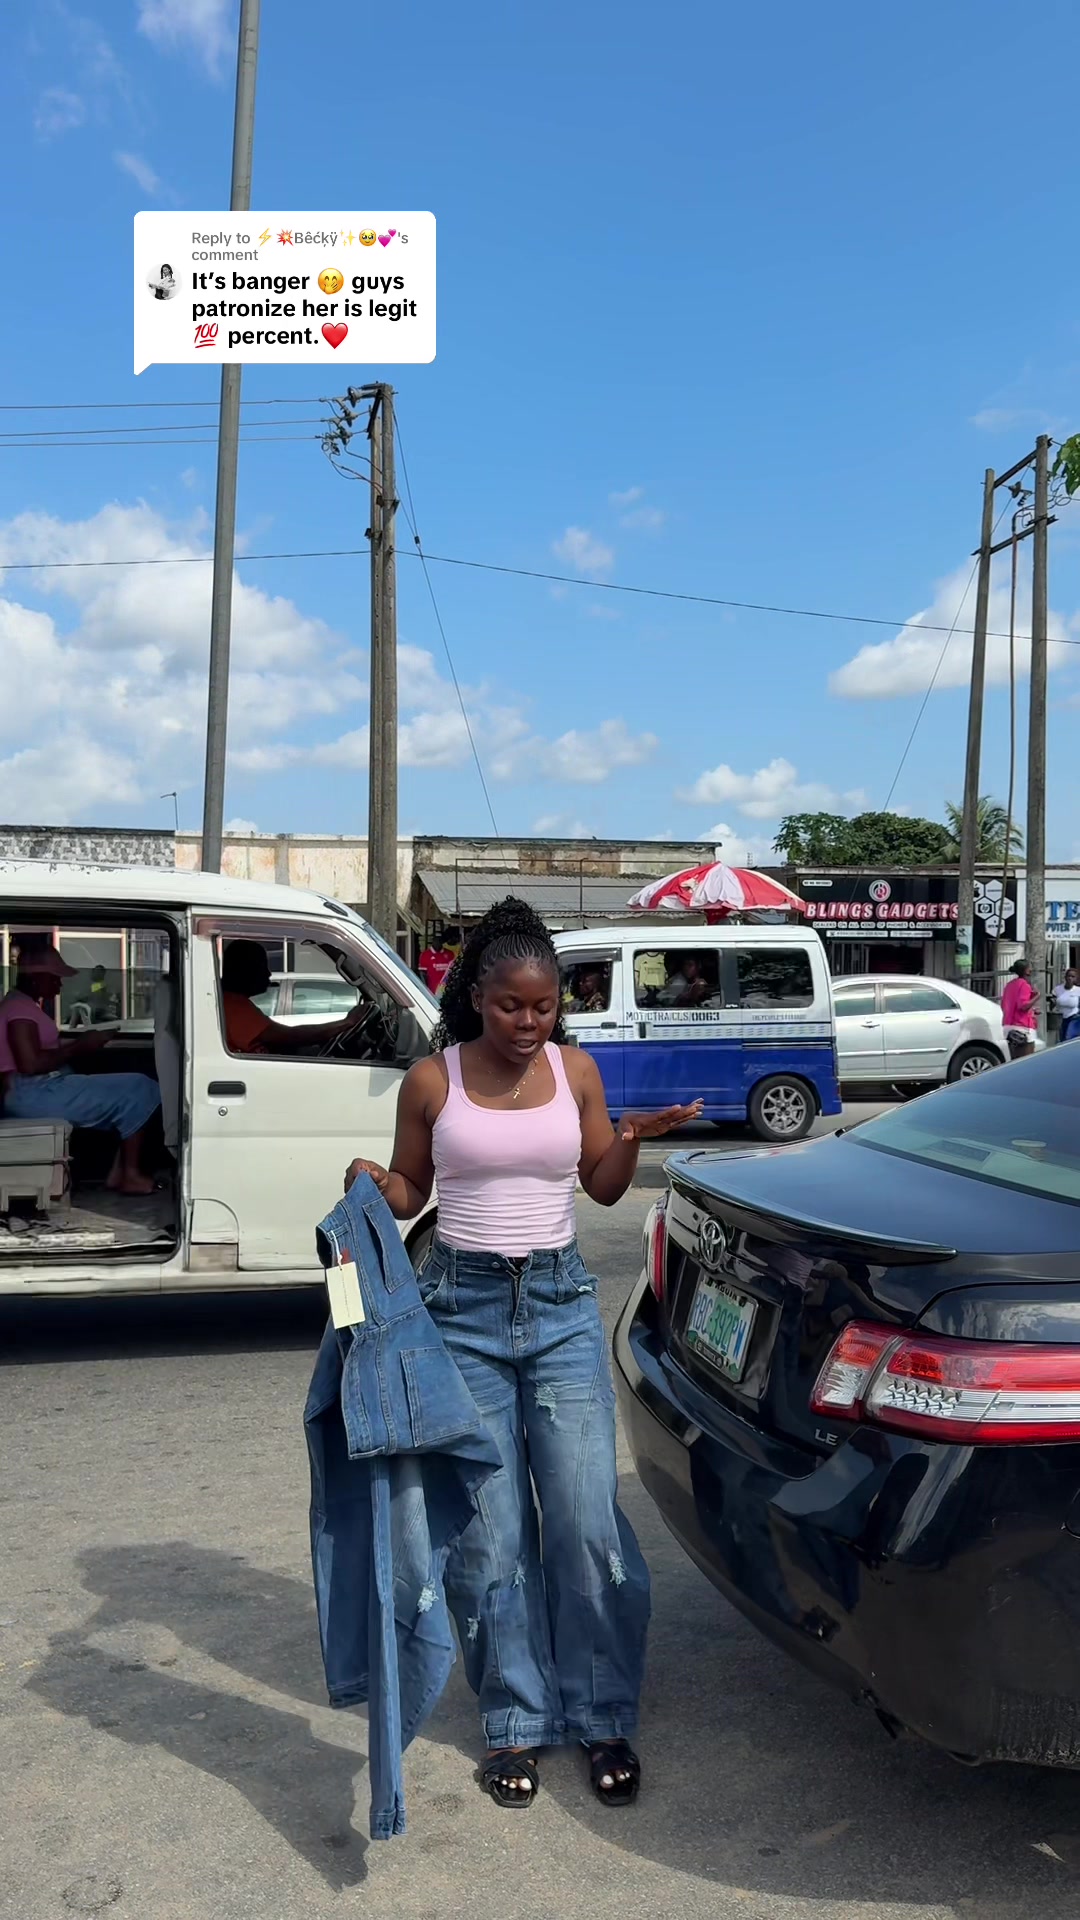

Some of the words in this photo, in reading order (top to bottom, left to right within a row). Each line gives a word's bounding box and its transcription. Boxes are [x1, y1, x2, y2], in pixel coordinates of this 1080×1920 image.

[804, 902, 873, 919] BLINGS
[876, 902, 958, 919] GADGETS
[815, 1429, 839, 1446] LE
